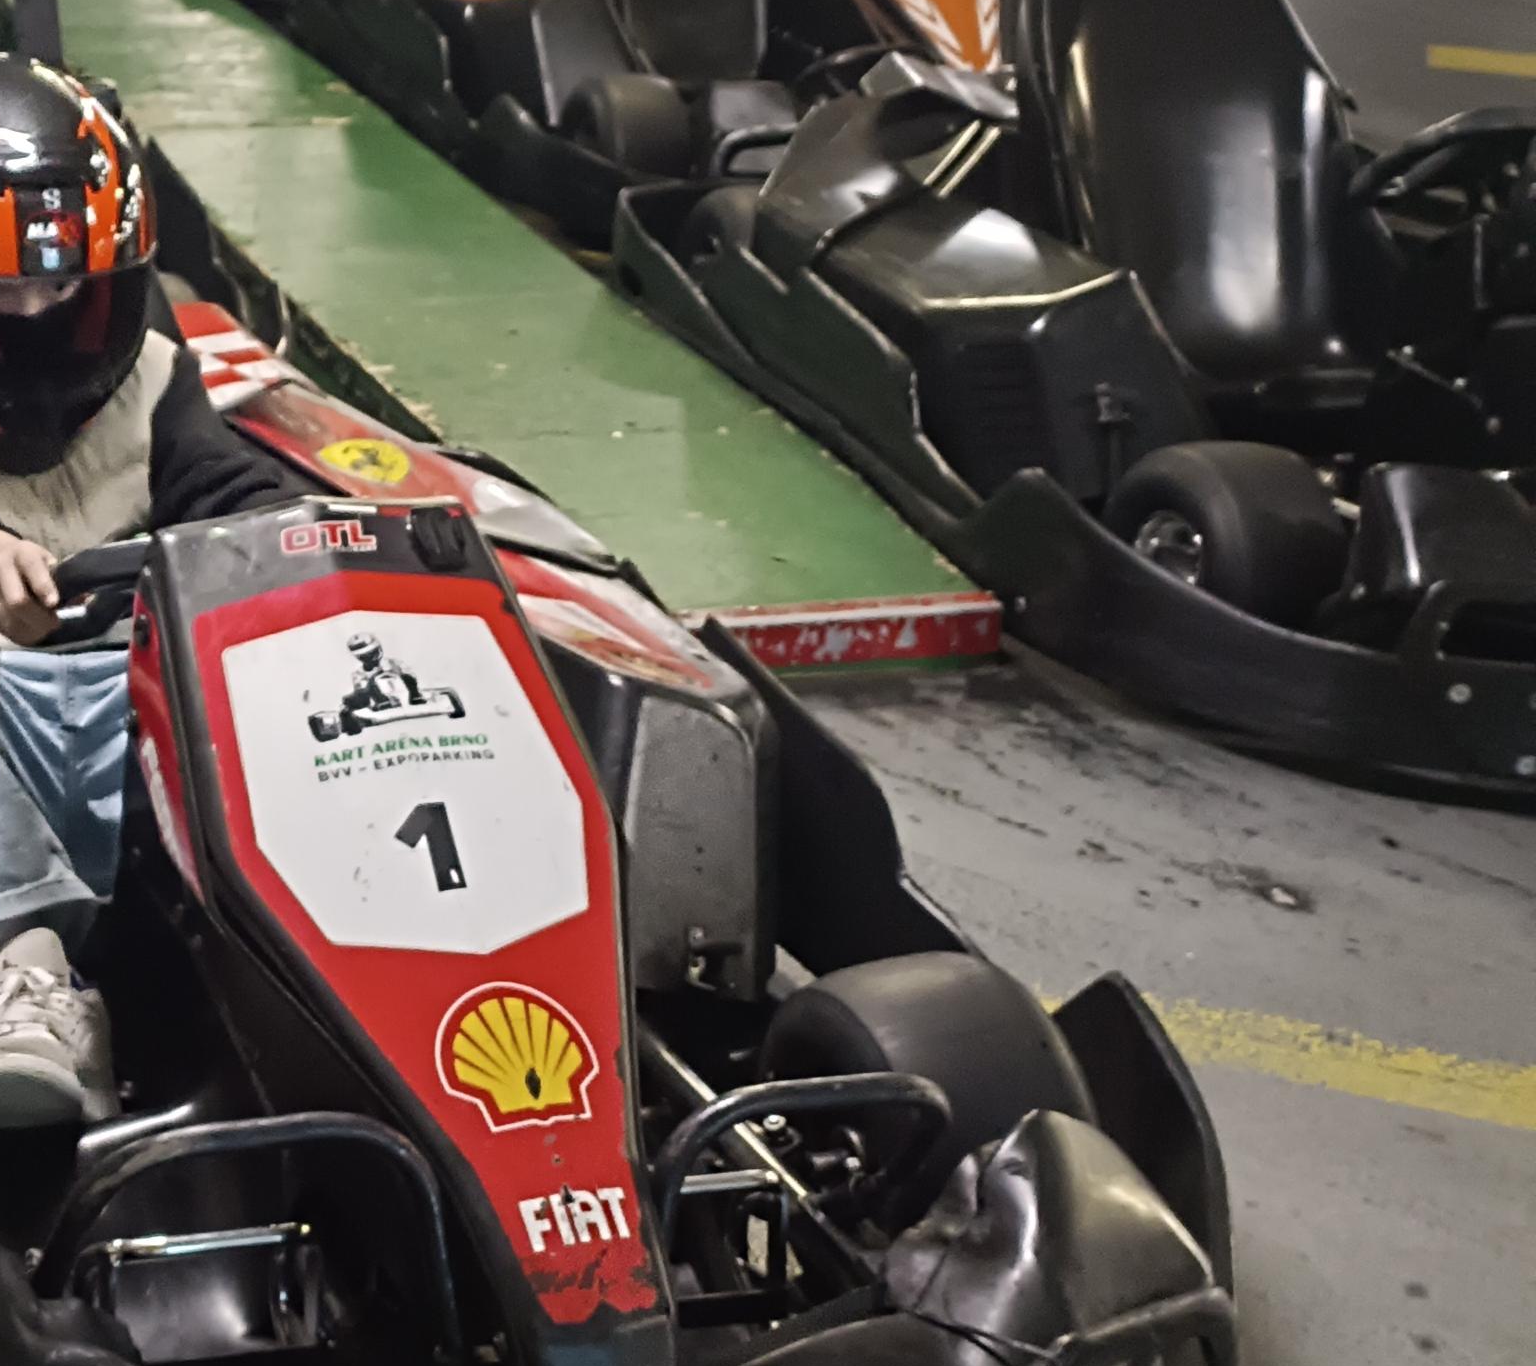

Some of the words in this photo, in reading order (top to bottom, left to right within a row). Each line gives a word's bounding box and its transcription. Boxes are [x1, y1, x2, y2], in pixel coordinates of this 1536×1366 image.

[281, 519, 377, 554] OTL
[314, 745, 366, 767] KART
[438, 733, 488, 748] BRNO
[317, 765, 352, 783] BVV
[373, 749, 495, 771] EXPOPARKING
[394, 802, 467, 893] 1
[518, 1186, 631, 1253] FIAT
